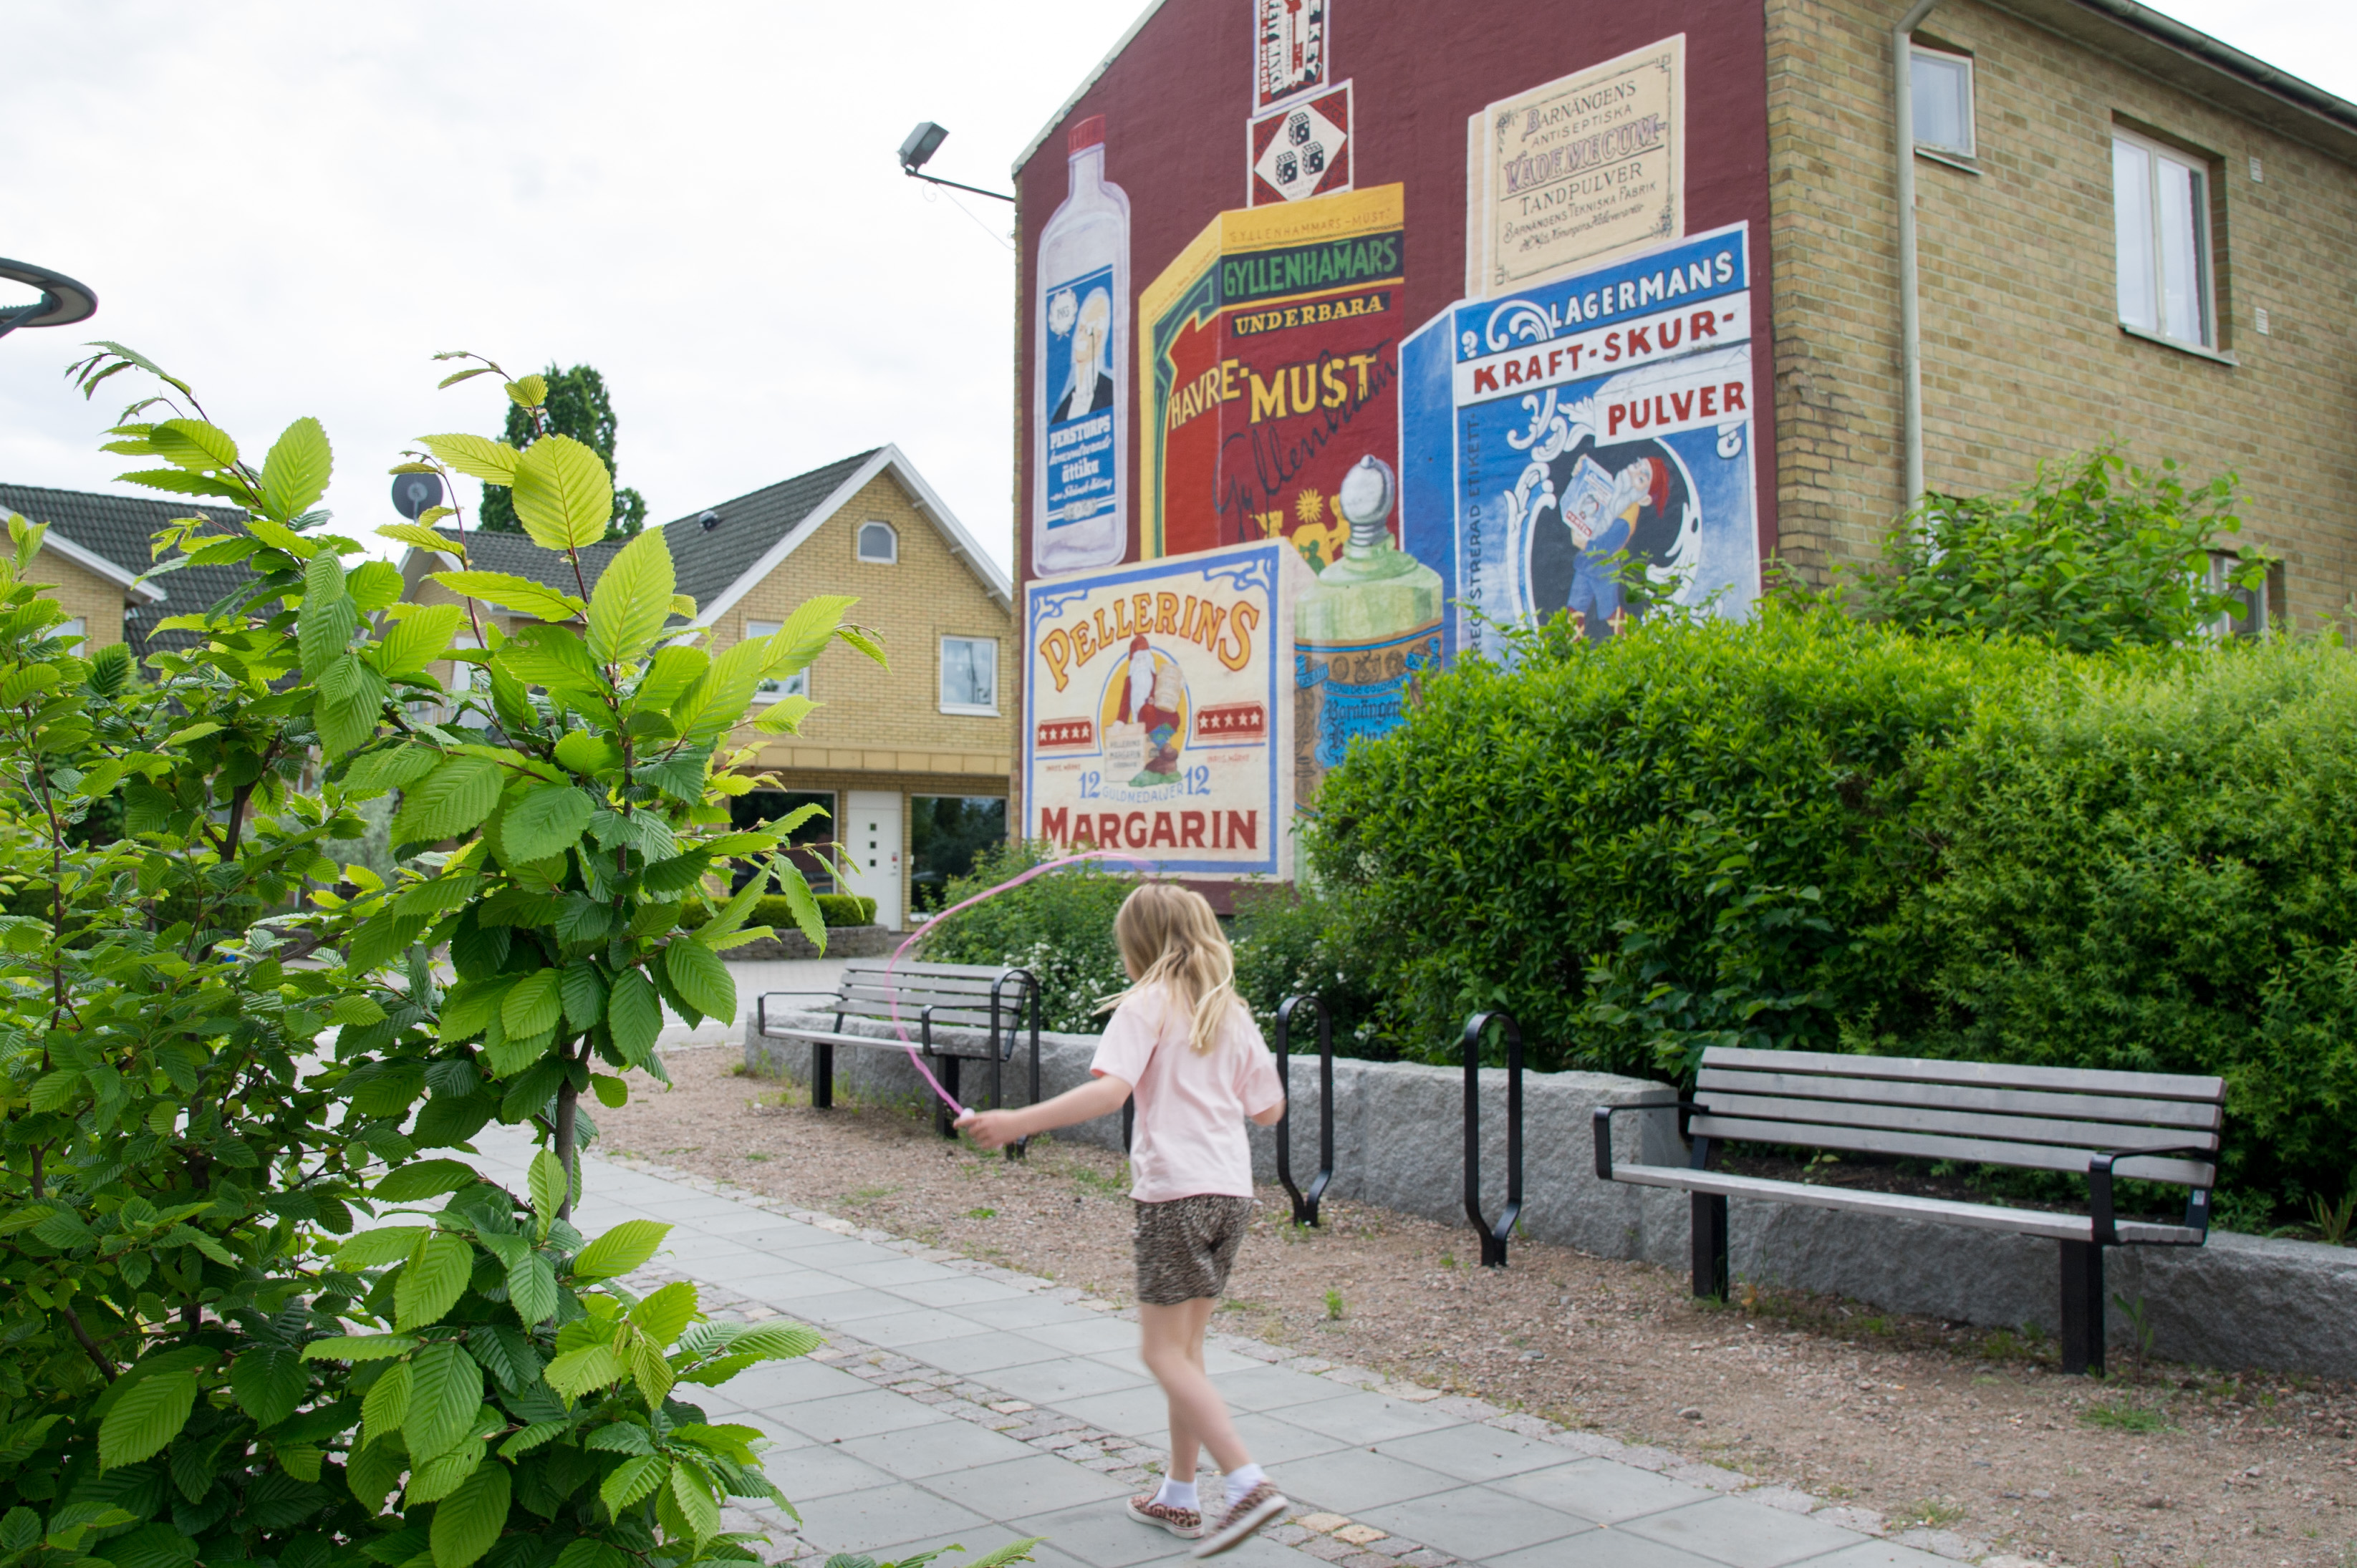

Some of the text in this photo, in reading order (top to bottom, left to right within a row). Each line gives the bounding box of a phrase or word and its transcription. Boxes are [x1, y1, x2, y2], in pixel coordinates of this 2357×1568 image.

[1261, 44, 1270, 93] SWEDEN
[1268, 39, 1284, 95] MATCH
[1306, 21, 1321, 76] KEY
[1531, 105, 1632, 148] ANTISEPTISKA
[1519, 162, 1643, 216] TANDPULVER
[1568, 195, 1616, 217] TEKNISKA
[1619, 180, 1657, 203] FABRIK
[1551, 251, 1734, 329] LAGERMANS
[1235, 294, 1384, 336] UNDERBARA
[1608, 381, 1747, 437] PULVER
[1039, 591, 1260, 693] PELLERINS
[1326, 699, 1401, 725] Barnängen
[1079, 765, 1210, 803] 12 GULDMEDALJER 12
[1041, 807, 1258, 849] MARGARIN
